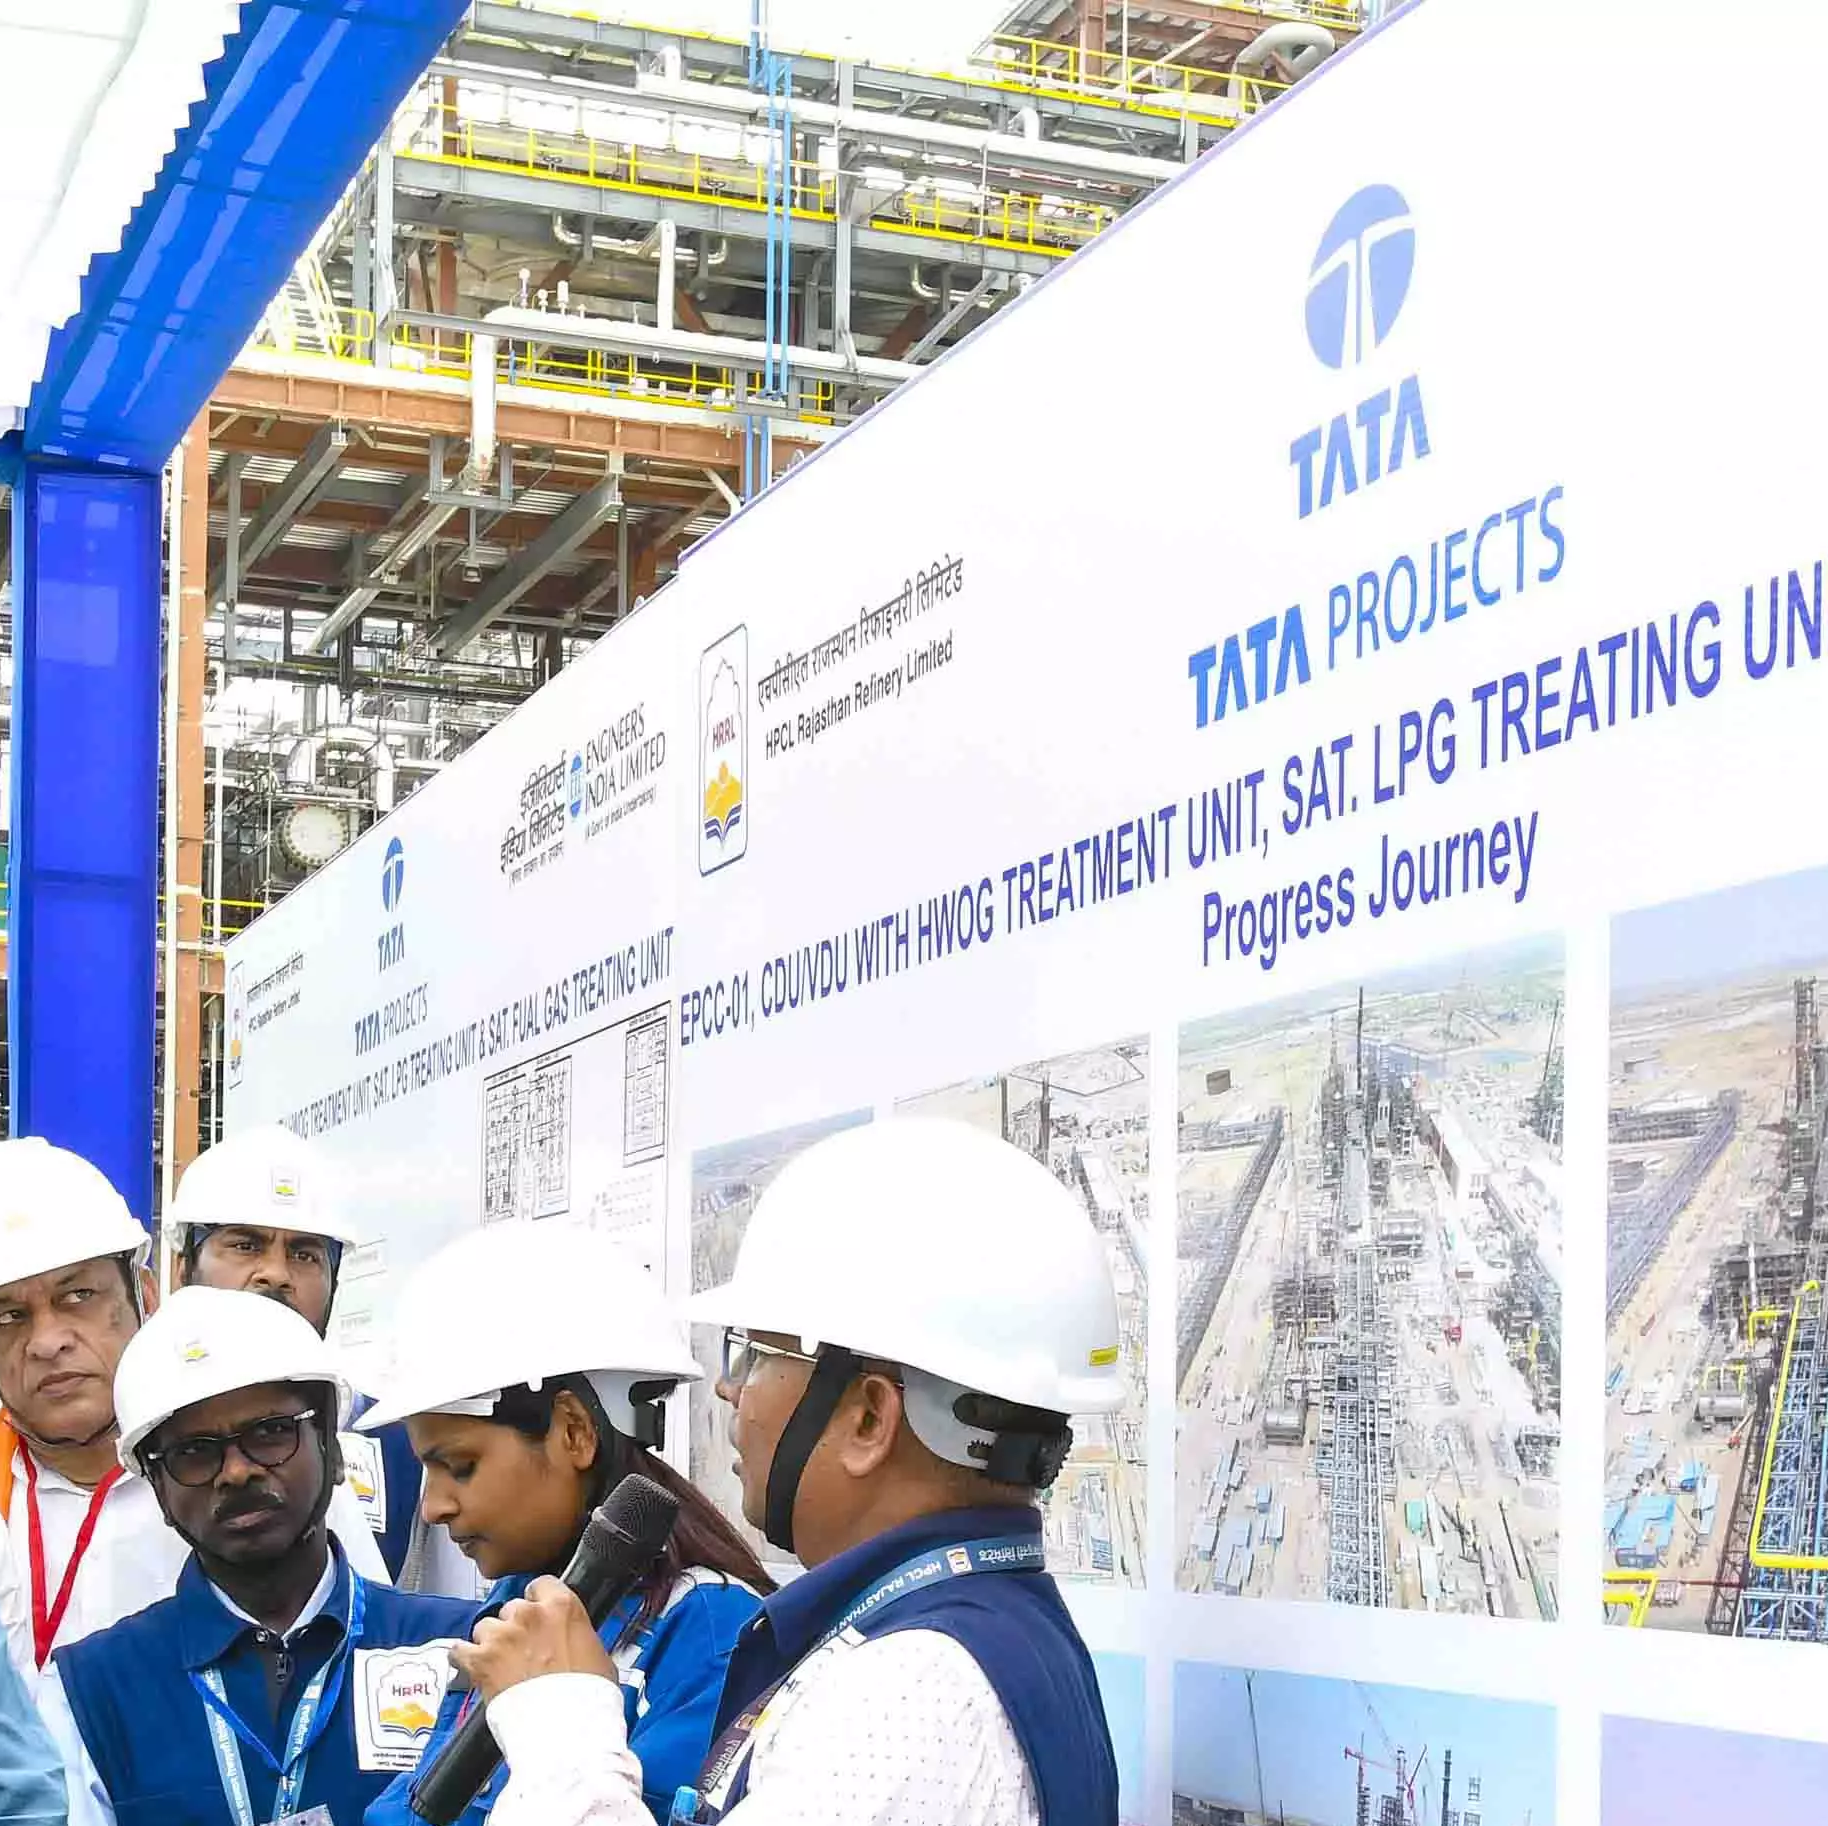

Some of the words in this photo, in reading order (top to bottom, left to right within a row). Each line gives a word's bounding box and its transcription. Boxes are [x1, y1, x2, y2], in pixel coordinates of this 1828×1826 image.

[1288, 374, 1433, 520] TATA
[758, 651, 809, 712] एचपीसीएल
[812, 624, 857, 676] राजस्थान
[860, 579, 913, 648] रिफाइनरी
[916, 553, 963, 616] लिमिटेड
[1187, 605, 1312, 729] TATA
[1326, 484, 1568, 672] PROJECTS
[712, 714, 736, 752] HRRL
[765, 719, 795, 760] HPCL
[797, 693, 851, 744] Rajasthan
[854, 665, 903, 713] Refinery
[907, 629, 953, 683] Limited
[585, 701, 645, 775] ENGINEERS
[585, 765, 616, 816] INDIA
[620, 731, 666, 790] LIMITED
[681, 969, 755, 1047] EPCC-01,
[761, 931, 848, 1019] CDU/VDU
[854, 908, 909, 985] WITH
[917, 877, 994, 965] HWOG
[1002, 803, 1177, 934] TREATMENT
[1186, 770, 1270, 876] UNIT,
[1280, 733, 1359, 836] SAT.
[1371, 696, 1457, 803] LPG
[1471, 599, 1723, 771] TREATING
[1201, 862, 1356, 970] Progress
[1368, 809, 1541, 926] Journey
[378, 922, 405, 973] TATA
[355, 1010, 381, 1057] TATA
[383, 982, 428, 1042] PROJECTS
[410, 1034, 452, 1092] TREATING
[455, 1022, 477, 1072] UNIT
[512, 992, 540, 1046] FUAL
[544, 978, 569, 1031] GAS
[573, 945, 636, 1018] TREATING
[640, 926, 674, 988] UNIT
[840, 1576, 905, 1627] RAJASTHAN
[907, 1560, 942, 1581] HPCL
[392, 1683, 430, 1697] HRRL
